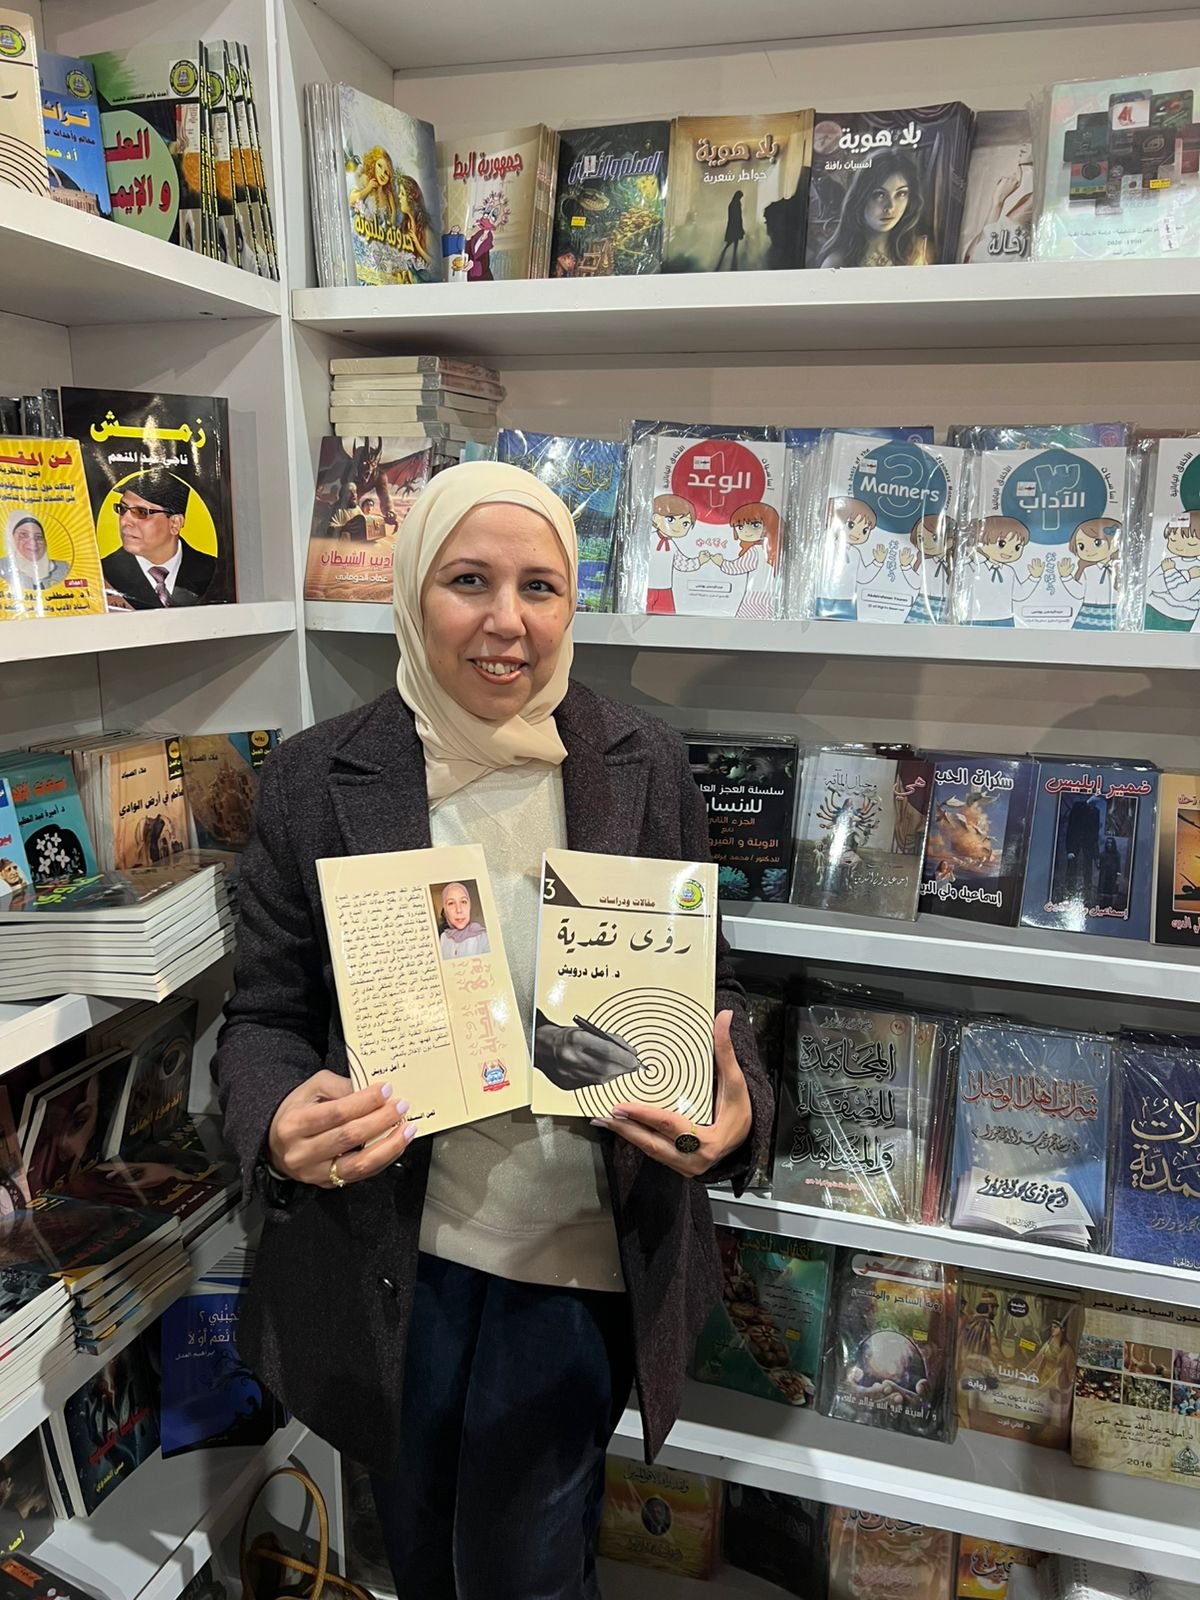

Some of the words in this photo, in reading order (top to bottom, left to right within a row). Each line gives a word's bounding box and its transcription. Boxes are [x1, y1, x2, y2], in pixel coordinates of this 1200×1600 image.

[105, 127, 150, 162] العل
[838, 127, 893, 153] هوية
[899, 121, 922, 149] بلا
[696, 137, 749, 166] هوية
[756, 133, 780, 163] بلا
[452, 152, 476, 181] البط
[477, 152, 523, 181] جمهورية
[737, 170, 767, 182] خواطر
[703, 170, 735, 184] شعرية
[0, 451, 43, 466] المق
[48, 451, 73, 469] فن
[108, 451, 137, 465] المنعم
[688, 471, 751, 493] الوعد
[860, 475, 940, 502] Manners
[1019, 491, 1085, 513] الآداب
[321, 551, 365, 567] الشيطان
[935, 768, 968, 787] الحب
[972, 771, 1014, 790] سكرات
[1045, 774, 1103, 796] إبليس
[700, 784, 716, 793] العا
[719, 784, 745, 795] العجز
[748, 786, 784, 796] سلسلة
[1106, 779, 1152, 799] ضمير
[119, 800, 143, 819] الوادي
[543, 879, 556, 900] 3
[937, 885, 958, 902] ولي
[959, 886, 1002, 908] إسماعيل
[599, 896, 631, 907] ودراسات
[632, 898, 656, 908] مقالات
[557, 918, 618, 954] نقدية
[630, 926, 691, 955] رؤى
[558, 964, 587, 978] درويش
[590, 964, 609, 979] أمل
[390, 1063, 400, 1072] أمل
[799, 1035, 896, 1081] المجاهدة
[371, 1067, 388, 1076] درويش
[962, 1070, 1022, 1112] الوصل
[796, 1079, 896, 1128] للصفاء
[789, 1127, 896, 1175] والمشاهدة
[1092, 1300, 1113, 1308] مصر
[1131, 1304, 1174, 1318] السياحية
[1176, 1314, 1200, 1323] فنون
[998, 1365, 1040, 1383] هداسا
[967, 1380, 987, 1391] رواية
[1126, 1457, 1152, 1468] 2016
